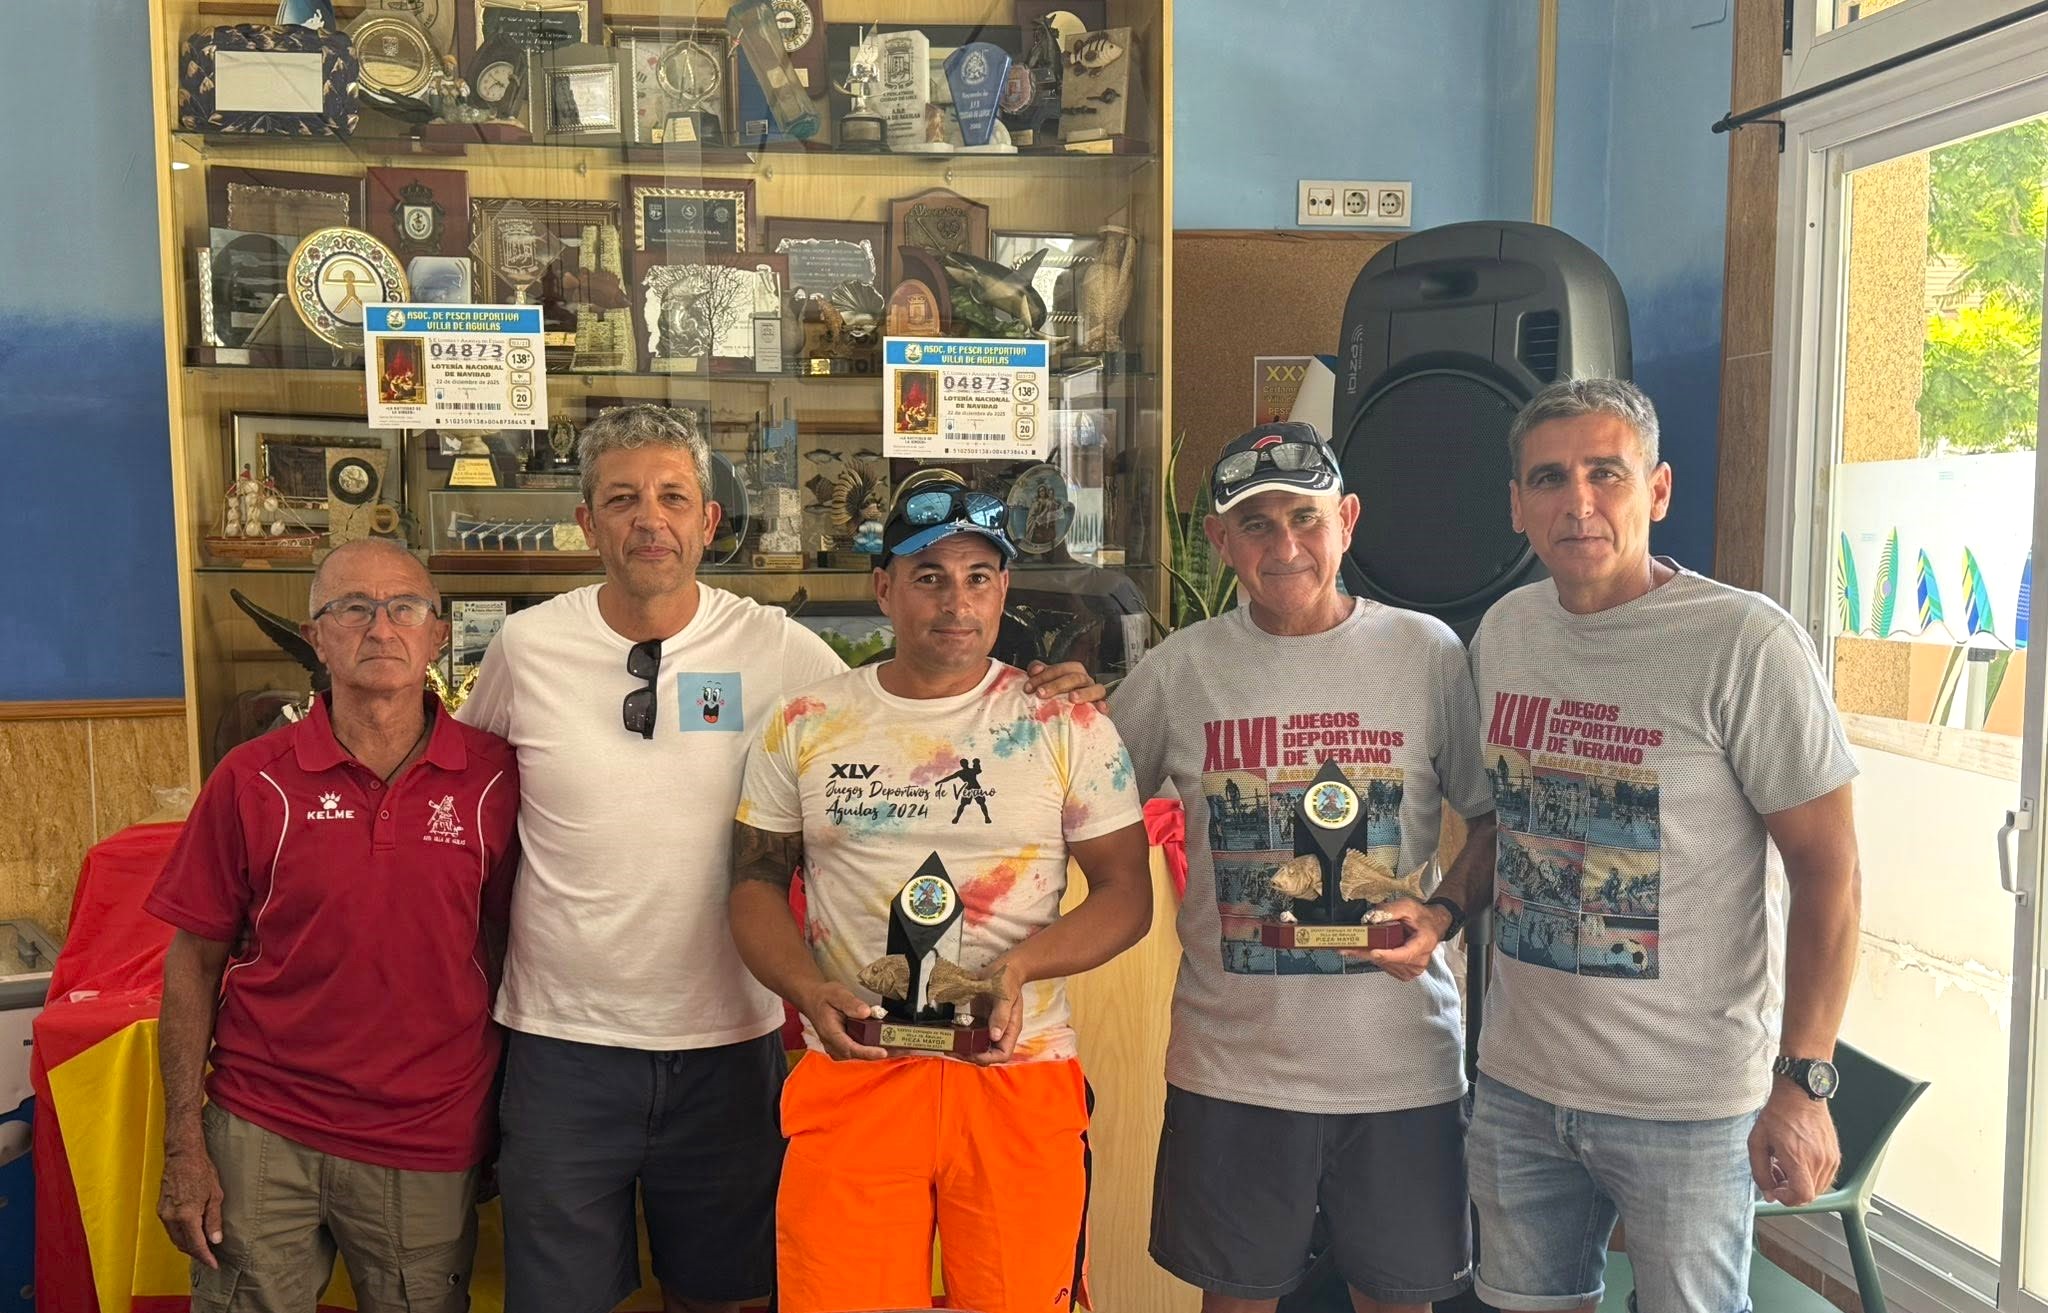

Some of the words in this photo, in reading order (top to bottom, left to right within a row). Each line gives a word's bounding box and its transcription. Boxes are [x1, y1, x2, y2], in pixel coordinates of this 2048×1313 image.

[407, 311, 431, 320] ASOC.
[433, 311, 444, 320] DE
[446, 312, 471, 321] PESCA
[473, 312, 519, 322] DEPORTIVA
[427, 321, 451, 330] VILLA
[453, 322, 464, 330] DE
[466, 322, 501, 331] AGUILAS
[430, 343, 503, 358] 04873
[924, 345, 945, 354] ASOC.
[947, 345, 957, 354] DE
[959, 346, 982, 355] PESCA
[984, 346, 1027, 356] DEPORTIVA
[431, 362, 463, 370] LOTERÍA
[941, 355, 963, 364] VILLA
[965, 355, 975, 364] DE
[977, 356, 1009, 365] AGUILAS
[944, 376, 1010, 391] 04873
[516, 394, 527, 403] 20
[1020, 425, 1030, 433] 20
[1553, 700, 1620, 722] JUEGOS
[1283, 712, 1360, 730] JUEGOS
[1487, 691, 1552, 750] XLVI
[1283, 730, 1404, 748] DEPORTIVOS
[1550, 718, 1664, 747] DEPORTIVOS
[1203, 716, 1278, 772] XLVI
[1546, 736, 1569, 755] DE
[1573, 739, 1644, 766] VERANO
[1283, 750, 1309, 766] DE
[1314, 748, 1392, 765] VERANO
[828, 763, 880, 779] XLV
[825, 780, 864, 802] Juegos
[868, 780, 930, 801] Deportivos
[935, 783, 947, 799] de
[952, 783, 997, 800] Verano
[307, 810, 356, 820] KELME
[886, 803, 929, 819] 2024
